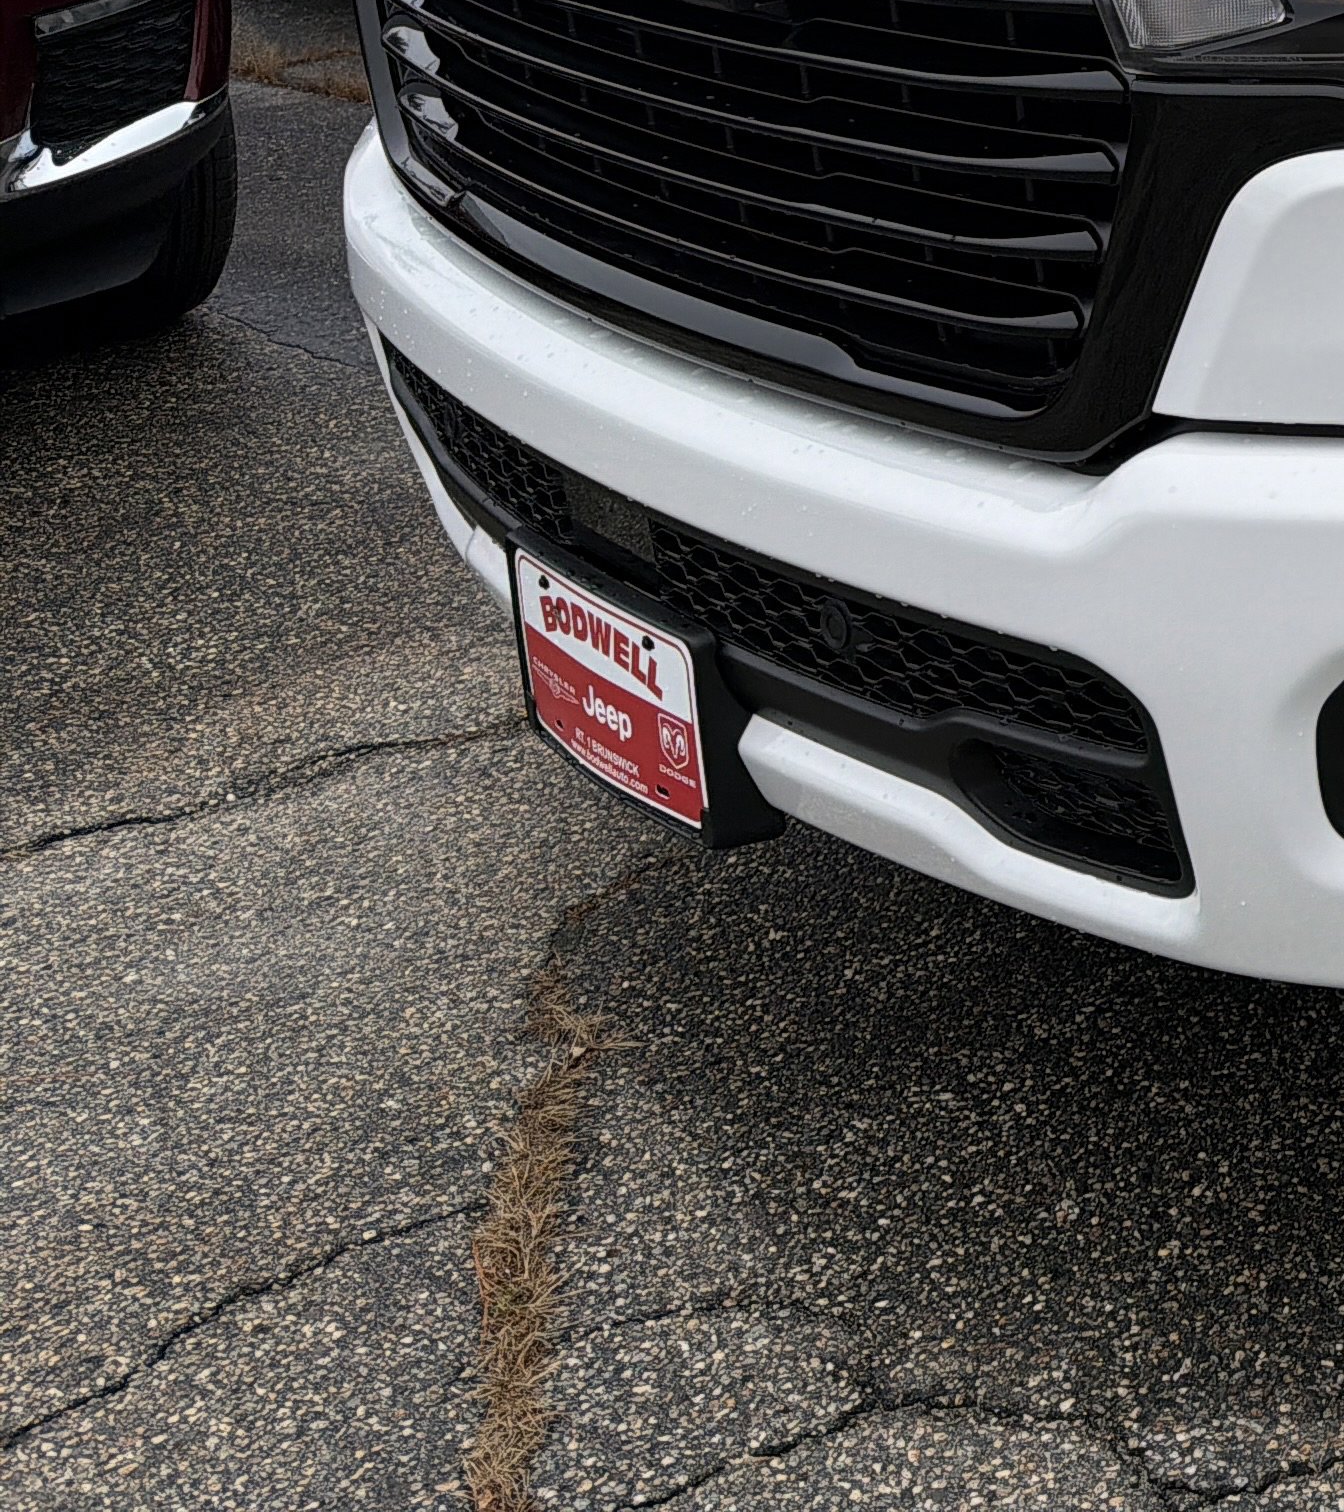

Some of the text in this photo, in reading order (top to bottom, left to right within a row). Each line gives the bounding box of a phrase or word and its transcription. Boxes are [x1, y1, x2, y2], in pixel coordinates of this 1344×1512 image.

[539, 595, 663, 701] BODWELL
[532, 656, 576, 696] CHRYSLER
[582, 685, 633, 742] Jeep
[570, 738, 649, 794] www.bodwellauto.com
[591, 738, 640, 778] BRUNSWICK
[658, 763, 697, 789] DODGE
